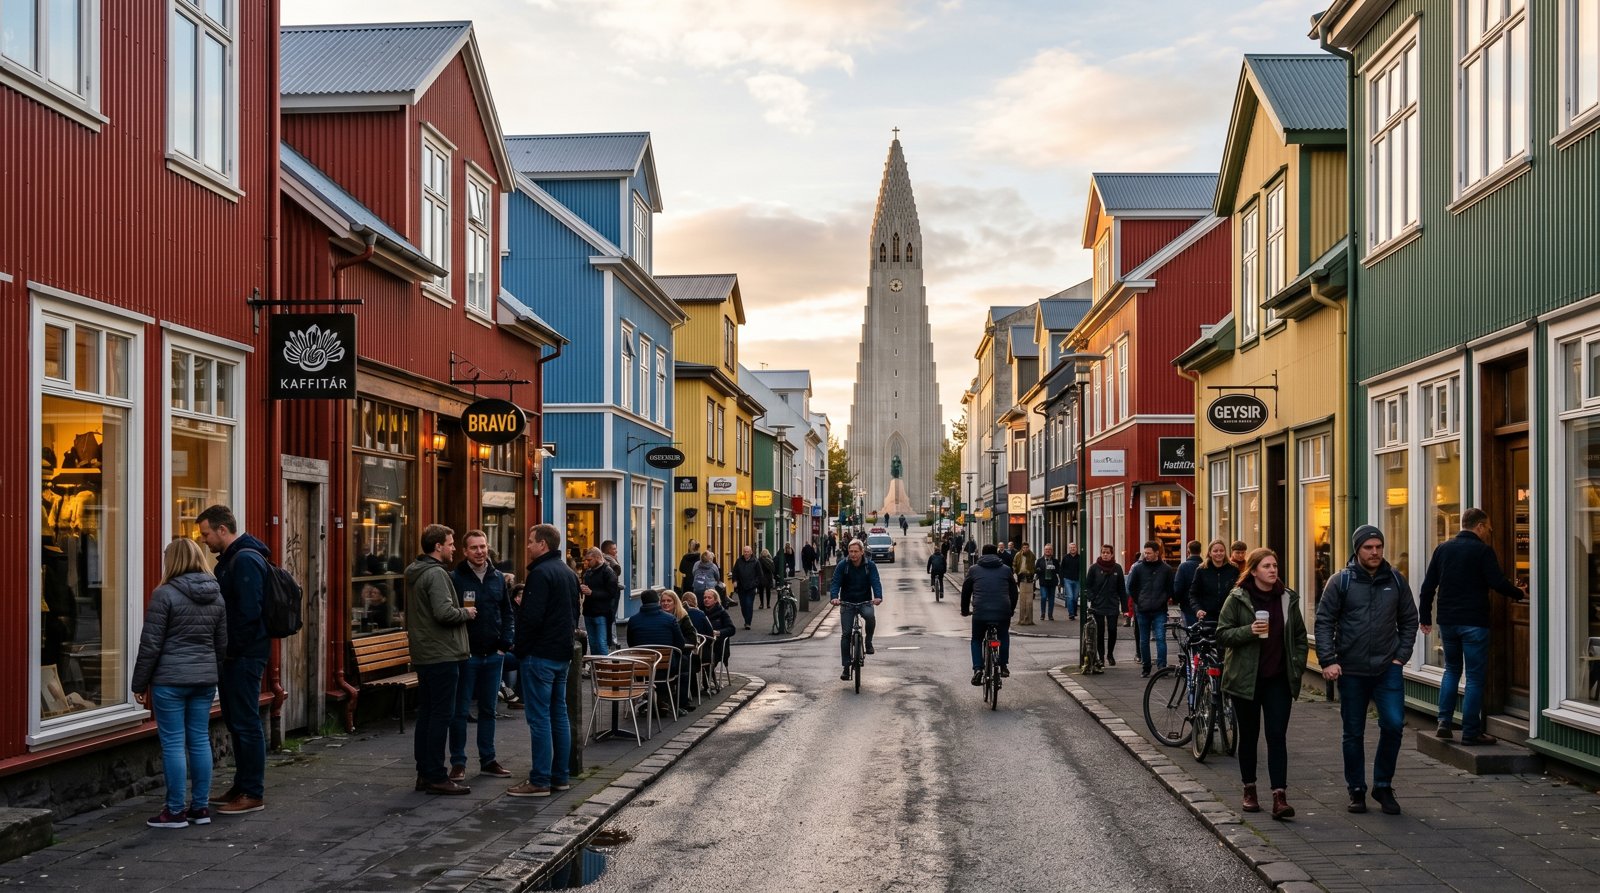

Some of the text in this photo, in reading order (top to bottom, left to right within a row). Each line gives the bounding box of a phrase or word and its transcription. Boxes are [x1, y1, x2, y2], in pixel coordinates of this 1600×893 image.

[280, 376, 347, 389] KAFFITÁR
[1214, 405, 1261, 419] GEYSIR
[468, 409, 517, 432] BRAVÓ
